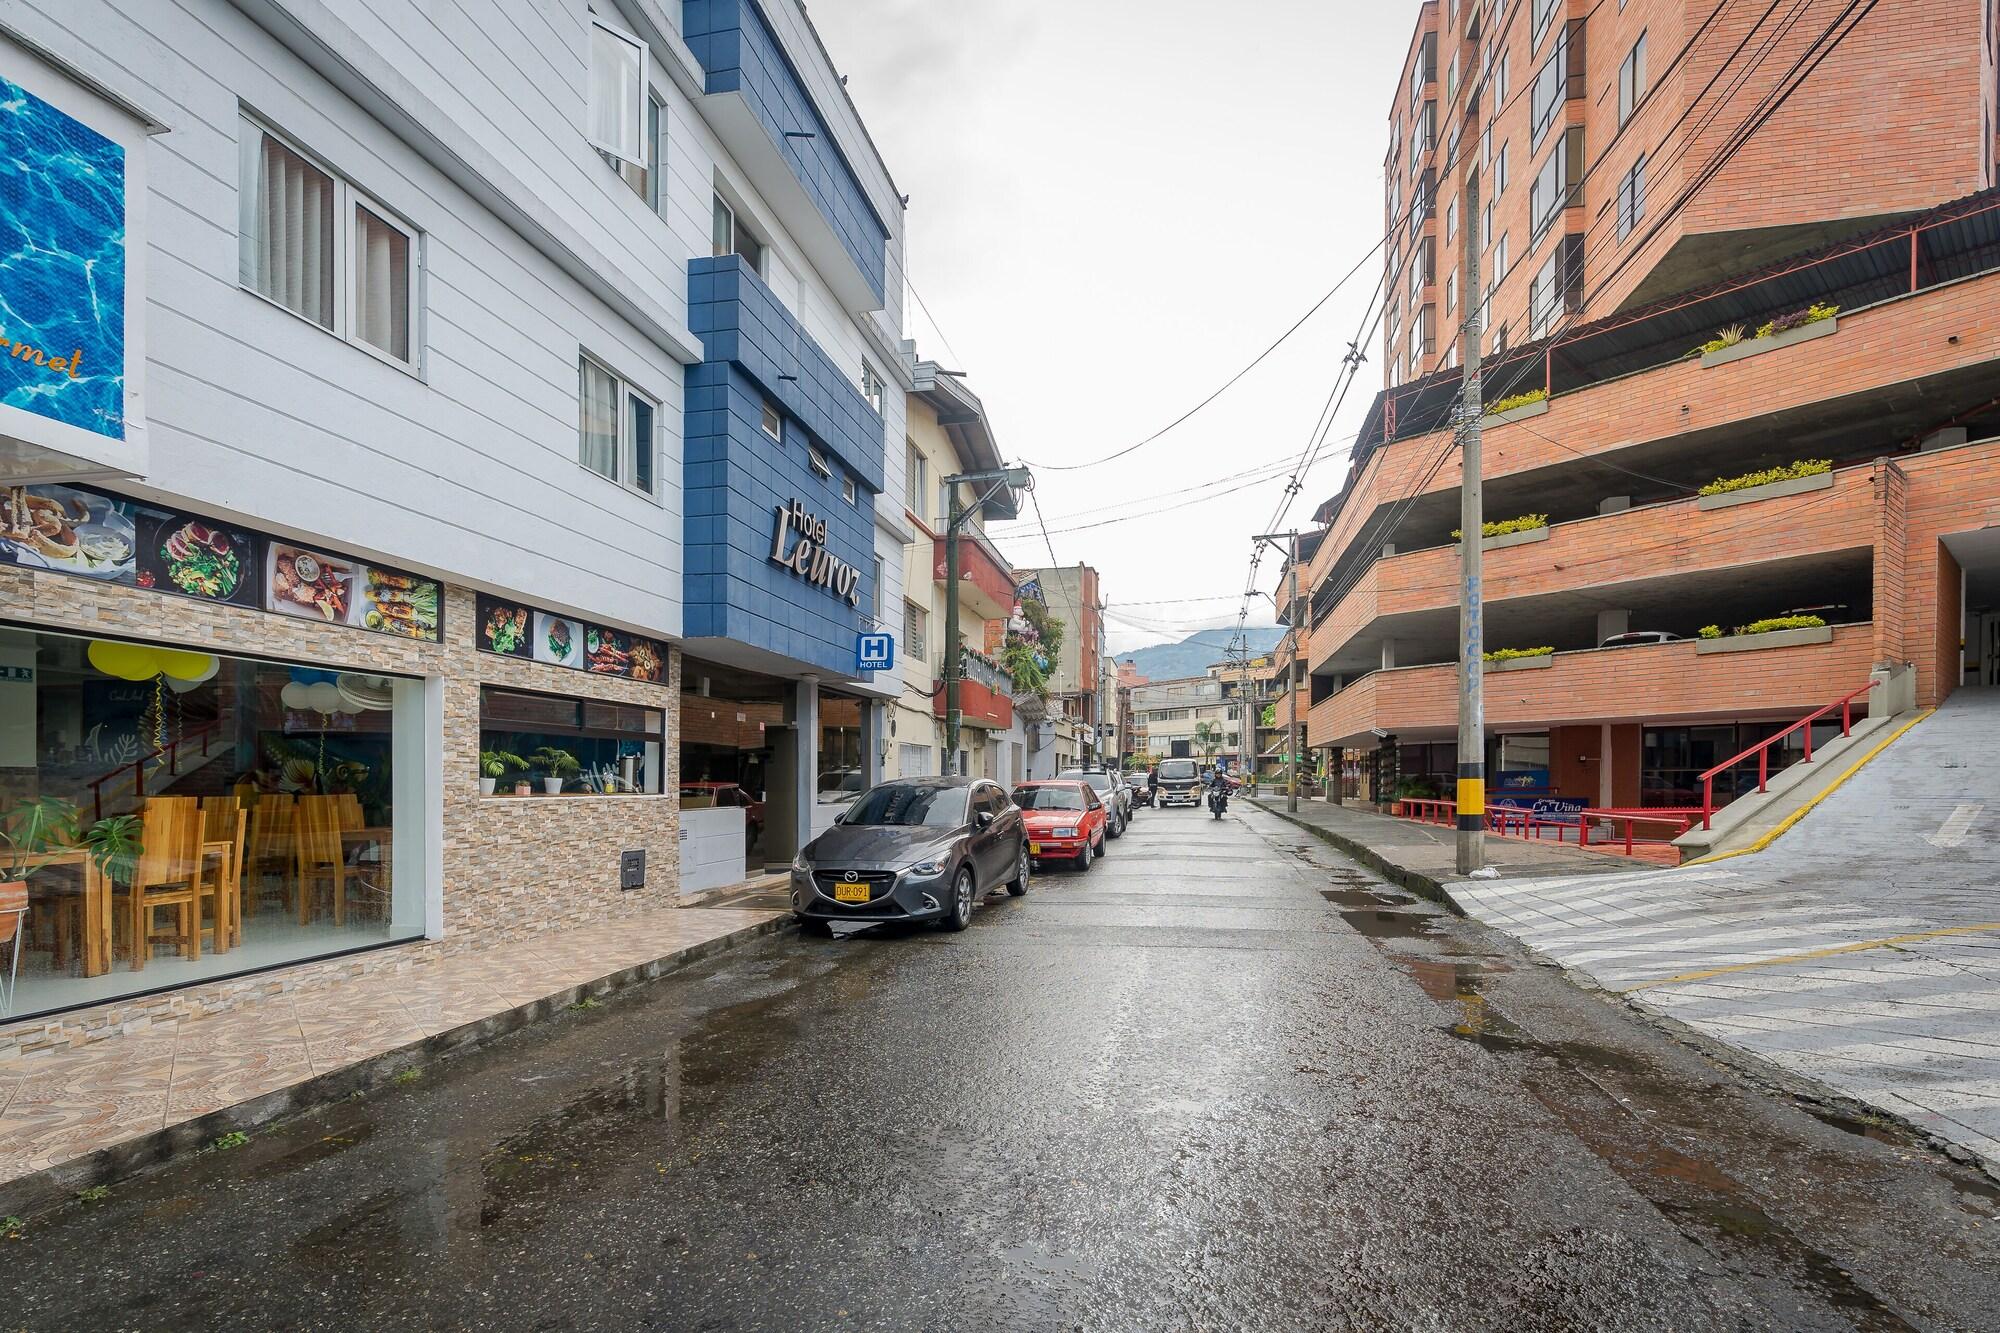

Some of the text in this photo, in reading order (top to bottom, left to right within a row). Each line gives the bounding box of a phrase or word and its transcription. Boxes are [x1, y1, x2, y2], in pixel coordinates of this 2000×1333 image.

[790, 498, 828, 547] Hotel
[770, 505, 861, 607] Leuroz
[1549, 801, 1582, 812] Viña
[836, 886, 867, 897] DUR-091
